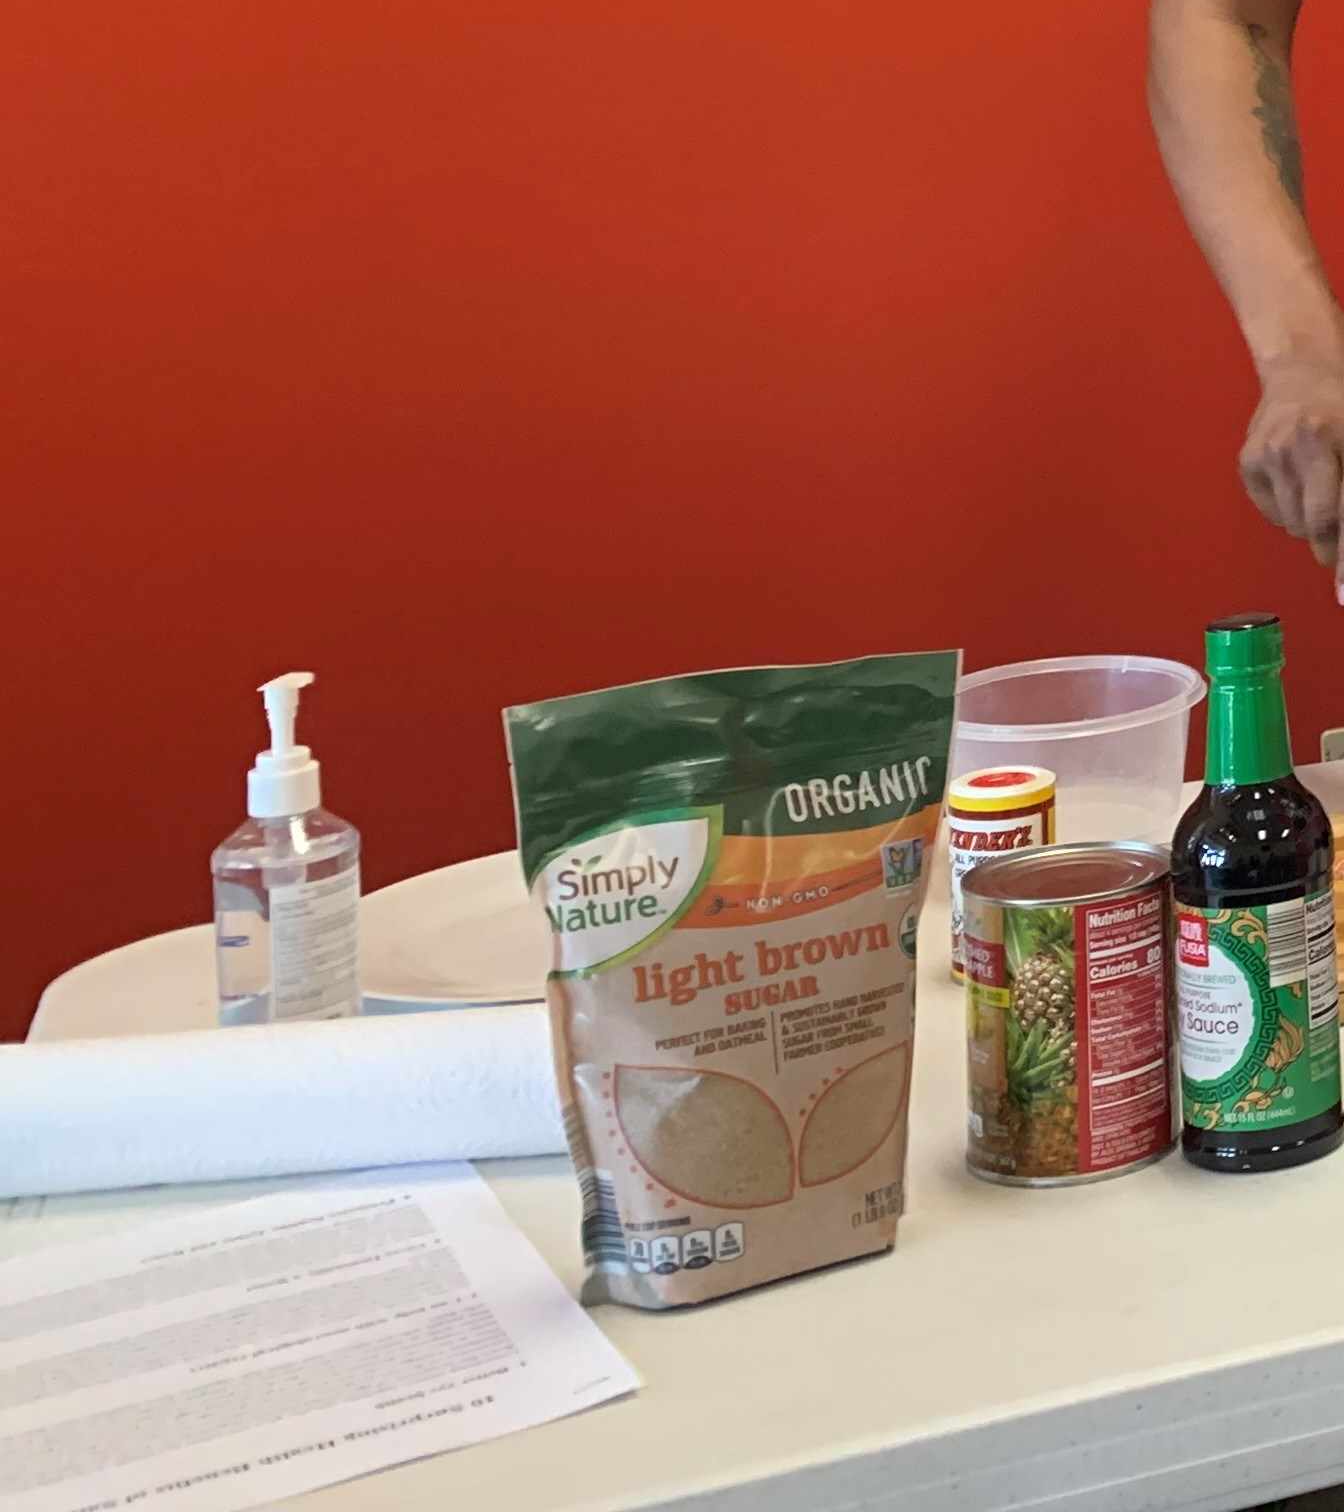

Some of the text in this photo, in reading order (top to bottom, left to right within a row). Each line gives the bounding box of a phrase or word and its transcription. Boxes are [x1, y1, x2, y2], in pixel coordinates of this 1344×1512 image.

[557, 855, 680, 902] Simply
[1089, 907, 1137, 929] Nutrition
[1137, 895, 1160, 918] Facts
[632, 921, 890, 1006] light brown
[1180, 939, 1207, 957] FUSIA
[1089, 959, 1139, 980] Calories
[724, 975, 820, 1016] SUGAR
[655, 1031, 700, 1051] PERFECT
[703, 1025, 724, 1039] FOR
[1186, 1011, 1240, 1035] Sauce
[343, 1402, 465, 1443] Surprising
[257, 1437, 338, 1467] Health
[154, 1460, 252, 1493] Benefits
